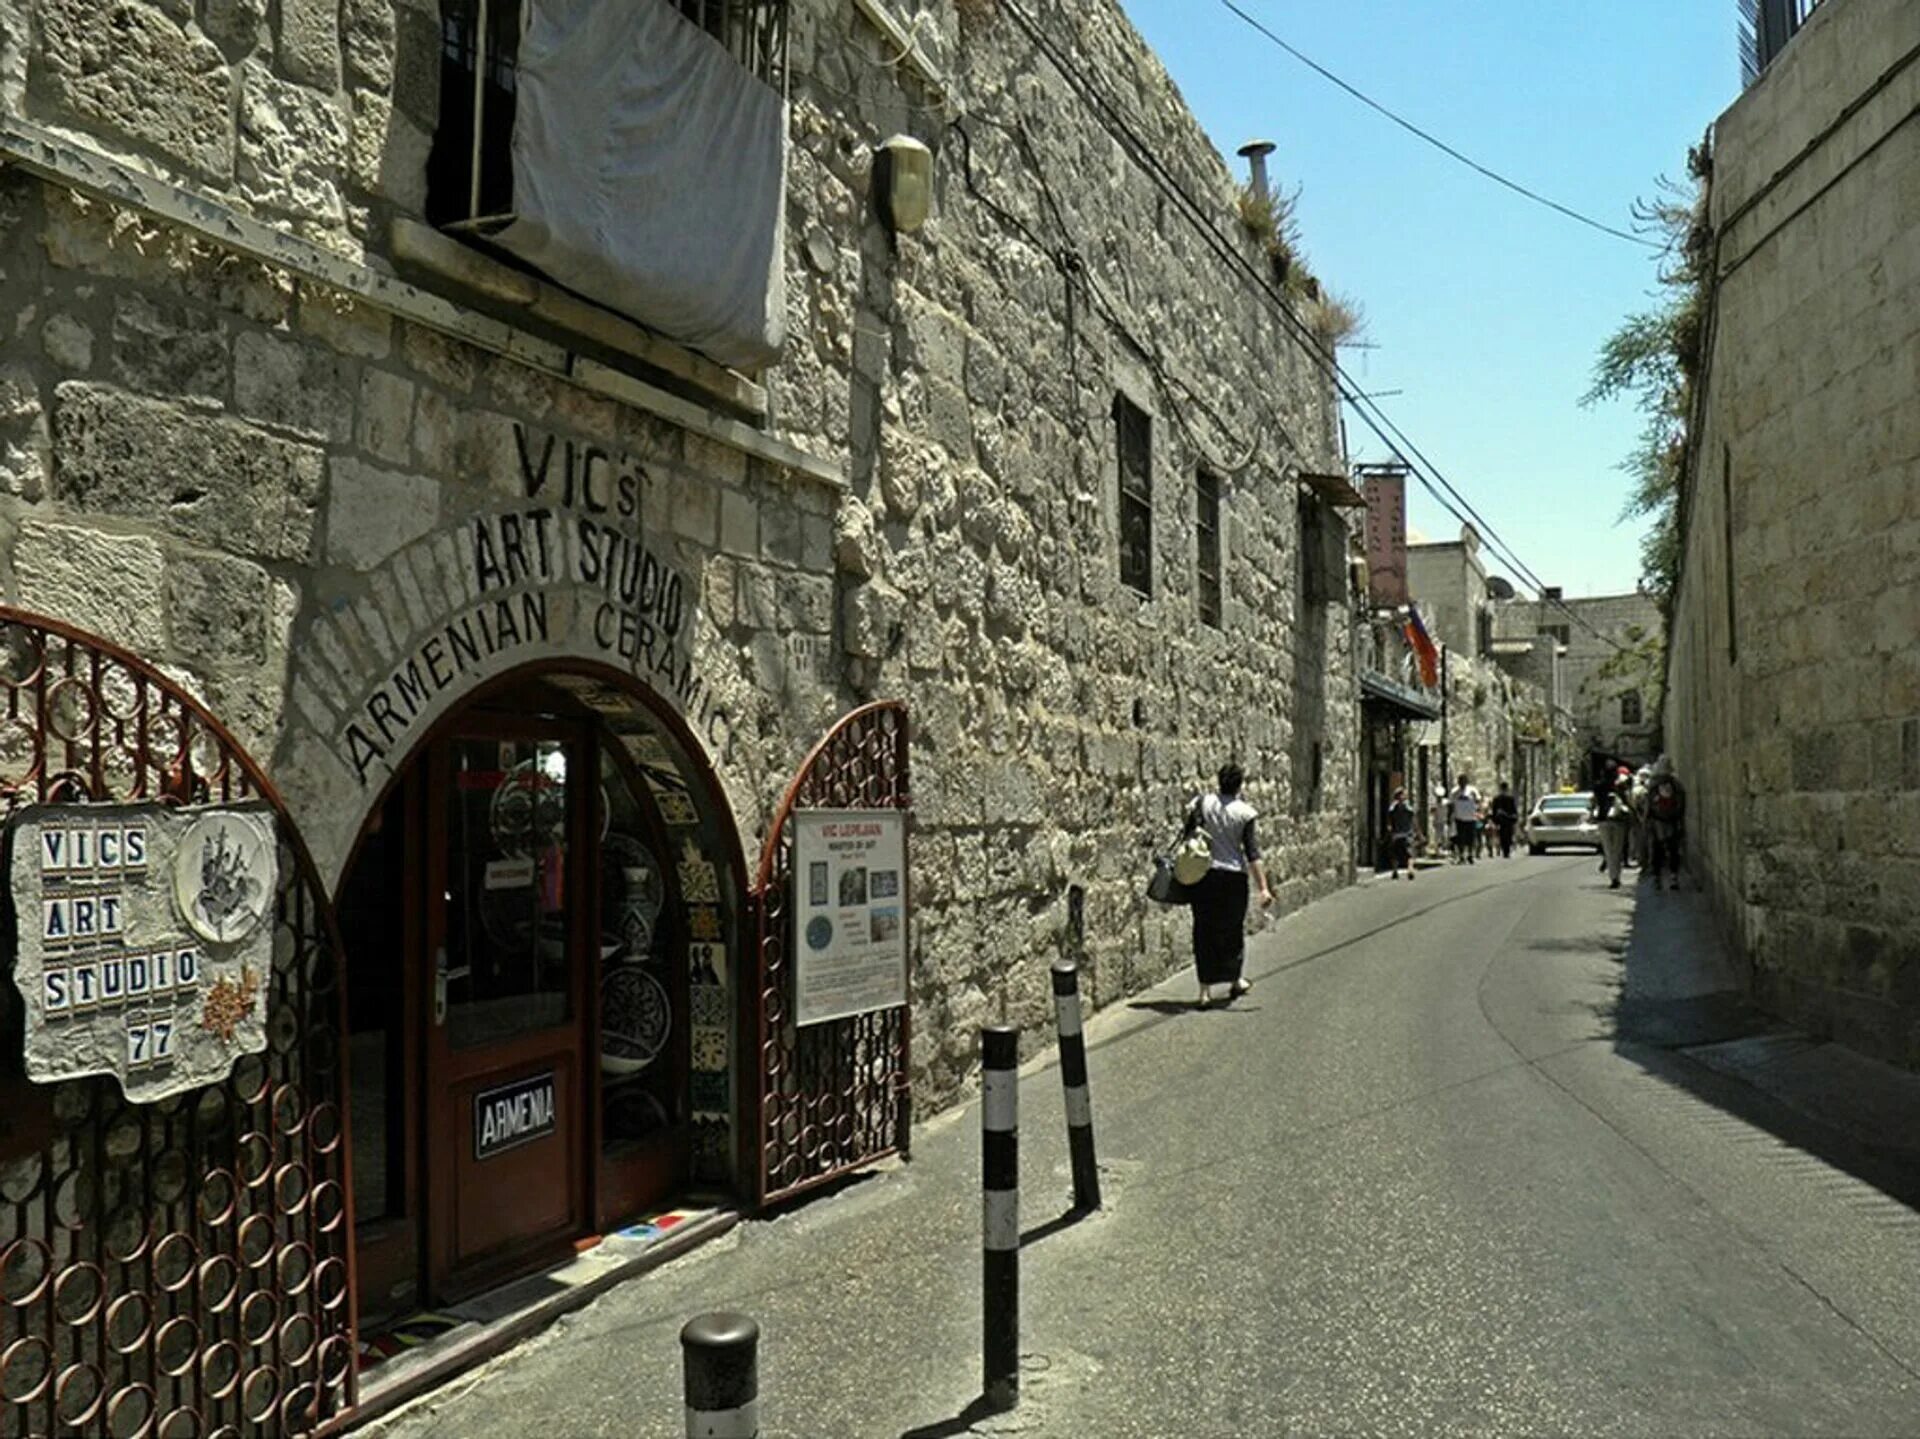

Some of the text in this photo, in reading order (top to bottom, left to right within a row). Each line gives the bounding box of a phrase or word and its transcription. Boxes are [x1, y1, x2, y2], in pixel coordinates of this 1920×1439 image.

[475, 508, 682, 637] ART STUDIO
[343, 591, 548, 786] ARMENIAN
[44, 831, 145, 865] VICS
[46, 897, 120, 936] ART
[46, 951, 195, 1006] STUDIO
[131, 1023, 171, 1060] 77
[481, 1085, 555, 1146] ARMENIA
